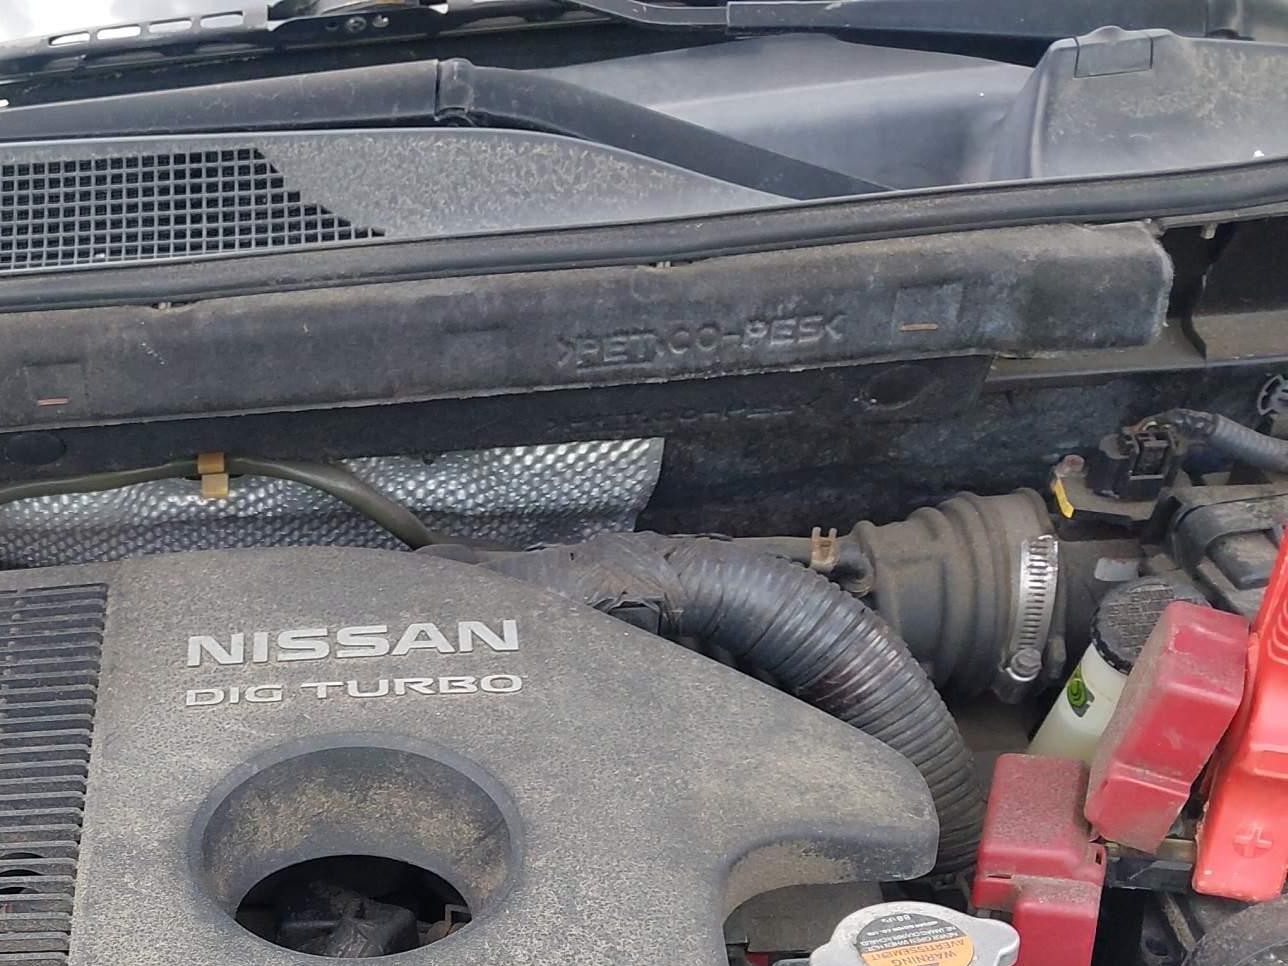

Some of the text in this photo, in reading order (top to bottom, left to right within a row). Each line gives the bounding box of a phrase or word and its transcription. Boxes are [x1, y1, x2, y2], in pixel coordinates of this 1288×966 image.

[186, 619, 520, 668] NISSAN
[185, 673, 524, 707] DIG TURBO
[871, 940, 966, 960] AVERTISSEMENT
[892, 949, 957, 966] WARNING
